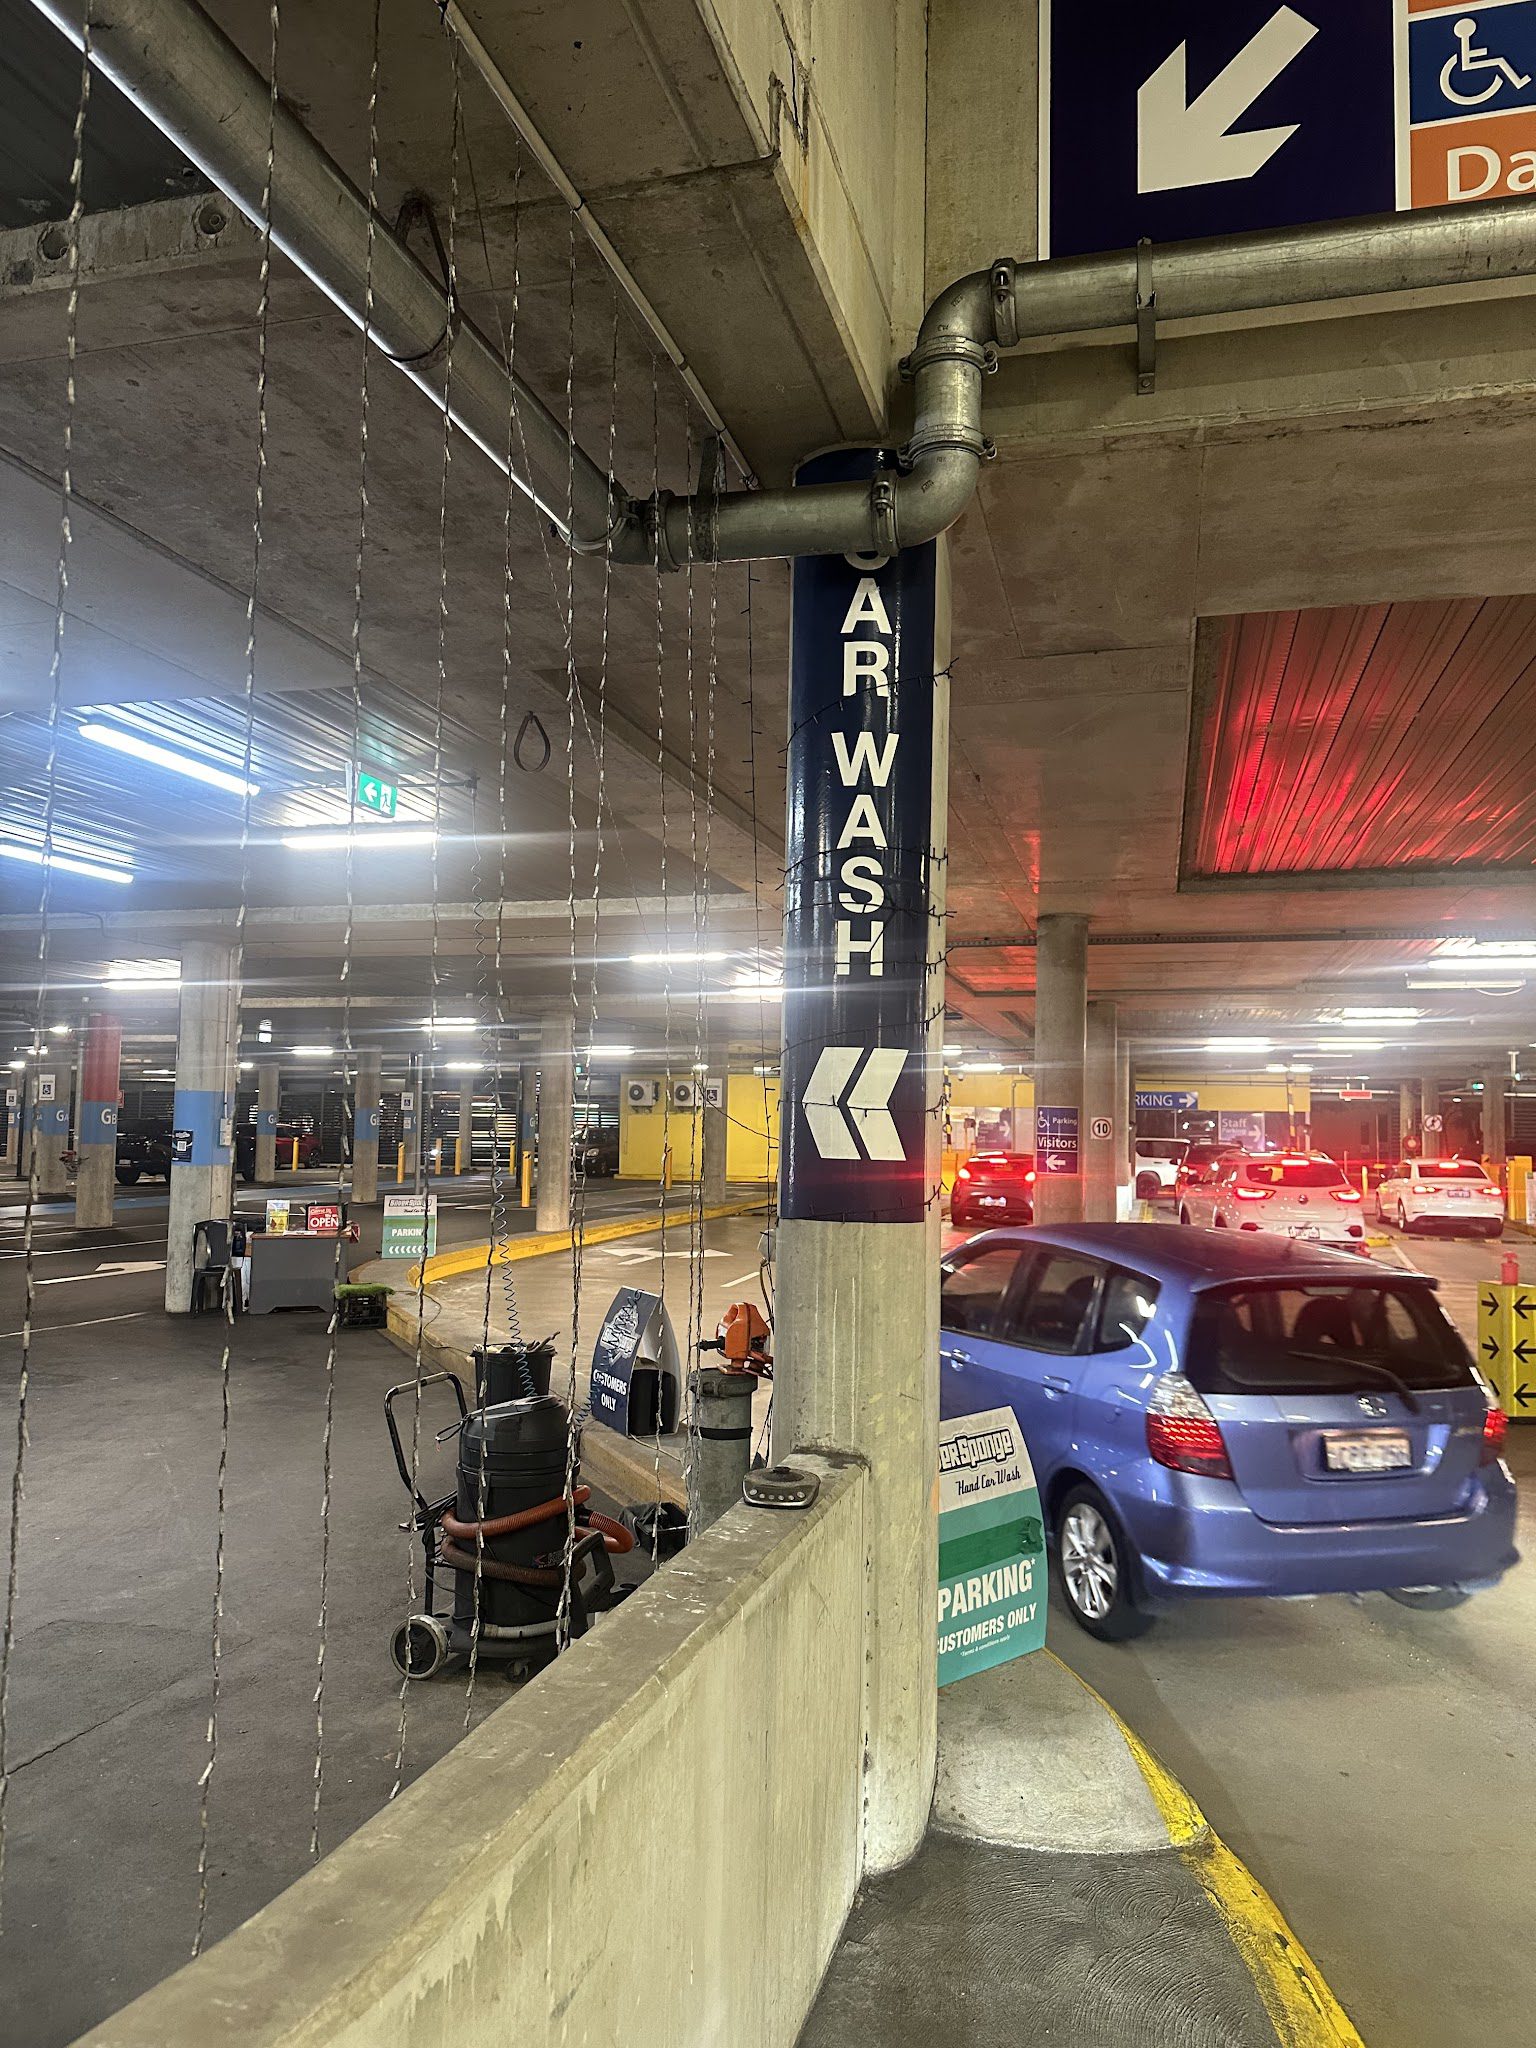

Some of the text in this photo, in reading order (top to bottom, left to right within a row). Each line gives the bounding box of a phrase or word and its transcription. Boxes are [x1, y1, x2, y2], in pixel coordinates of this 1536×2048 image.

[831, 731, 900, 977] WASH
[101, 1108, 118, 1125] GB
[1052, 1117, 1077, 1126] Parking
[1096, 1123, 1108, 1134] 10
[1222, 1118, 1247, 1128] Staff
[1037, 1136, 1077, 1148] Visitors
[310, 1217, 339, 1228] OPEN
[391, 1228, 424, 1237] PARKIN
[600, 1393, 617, 1412] ONLY
[955, 1465, 1021, 1496] Hand Car Wash
[937, 1602, 1037, 1655] USTOMERS ONLY
